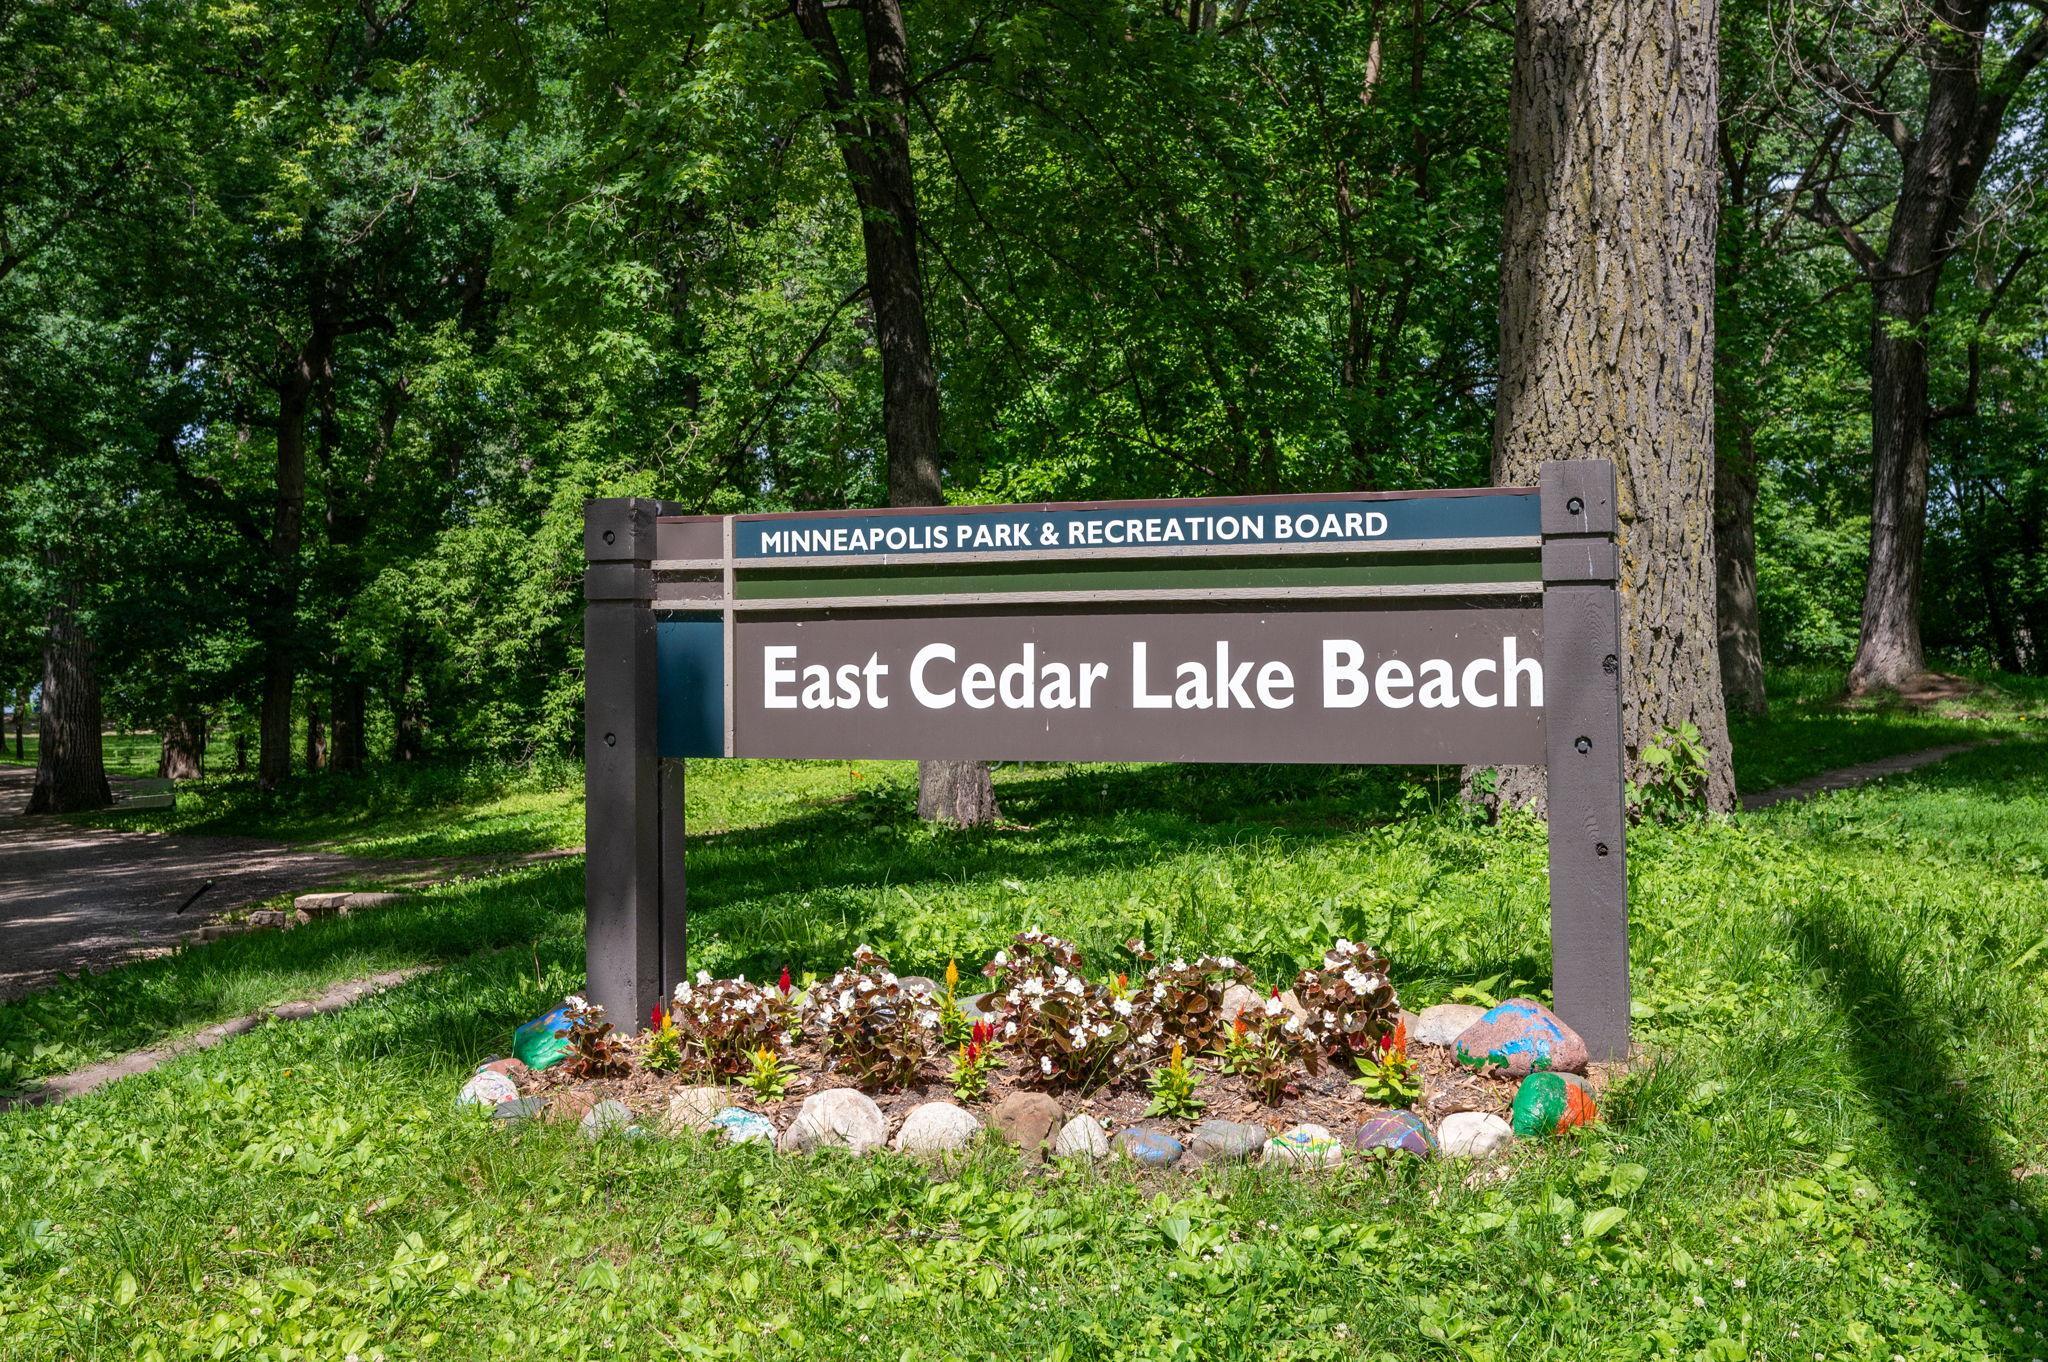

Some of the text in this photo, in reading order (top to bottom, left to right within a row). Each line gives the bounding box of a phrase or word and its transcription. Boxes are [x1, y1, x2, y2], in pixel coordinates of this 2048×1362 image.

[761, 511, 1387, 554] MINNEAPOLIS PARK & RECREATION BOARD
[763, 636, 1544, 710] East Cedar Lake Beach
